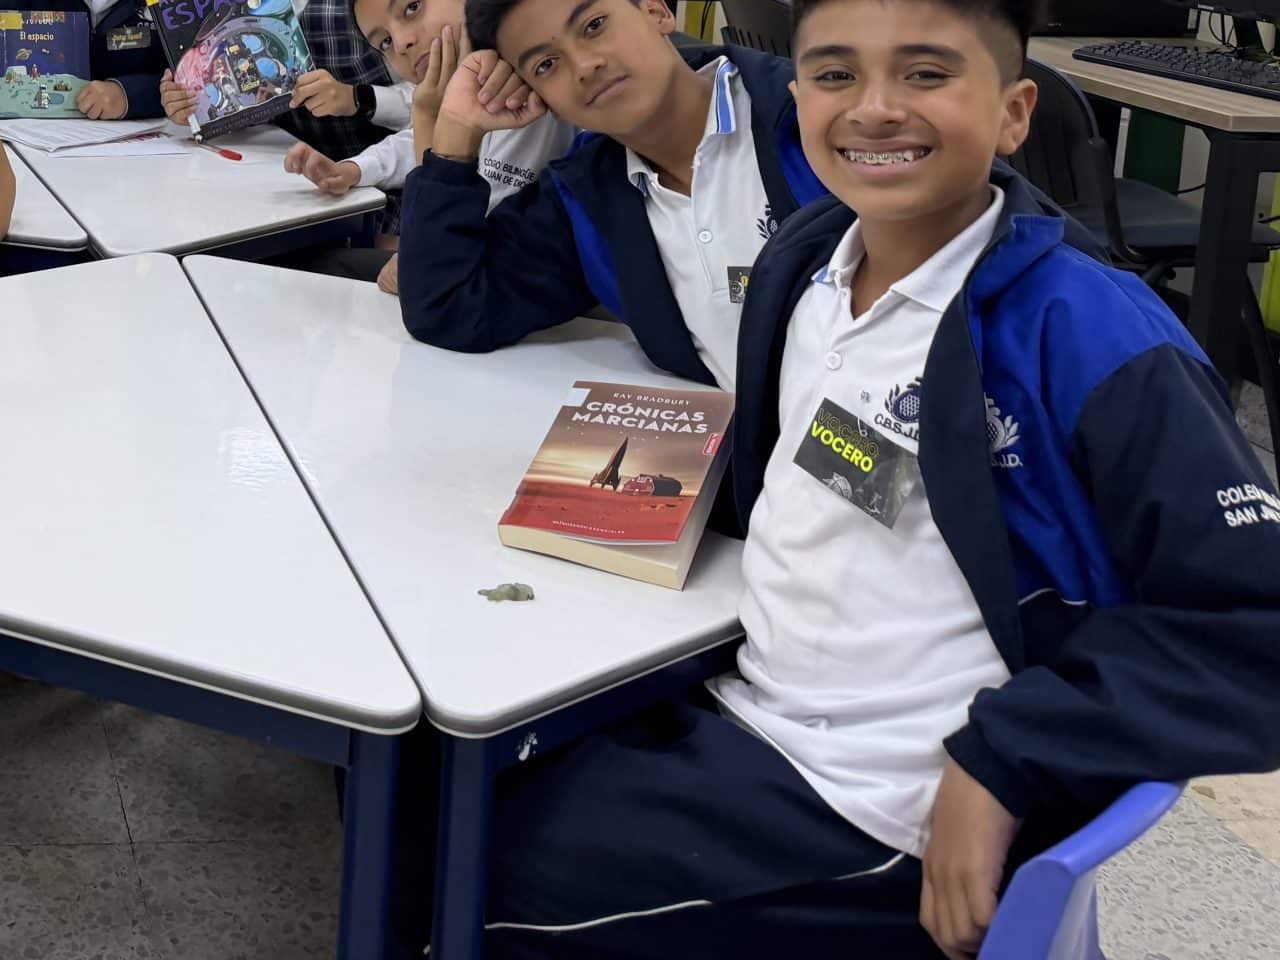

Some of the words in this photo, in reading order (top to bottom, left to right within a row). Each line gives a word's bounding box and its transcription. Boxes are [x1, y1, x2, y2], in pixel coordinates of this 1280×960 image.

[27, 31, 54, 44] espacio
[612, 391, 633, 400] RAY
[636, 394, 691, 406] BRADBURY
[571, 411, 709, 434] MARCIANAS
[586, 400, 705, 423] CRÓNICAS
[811, 420, 873, 473] VOCERO
[1223, 505, 1260, 527] SAN
